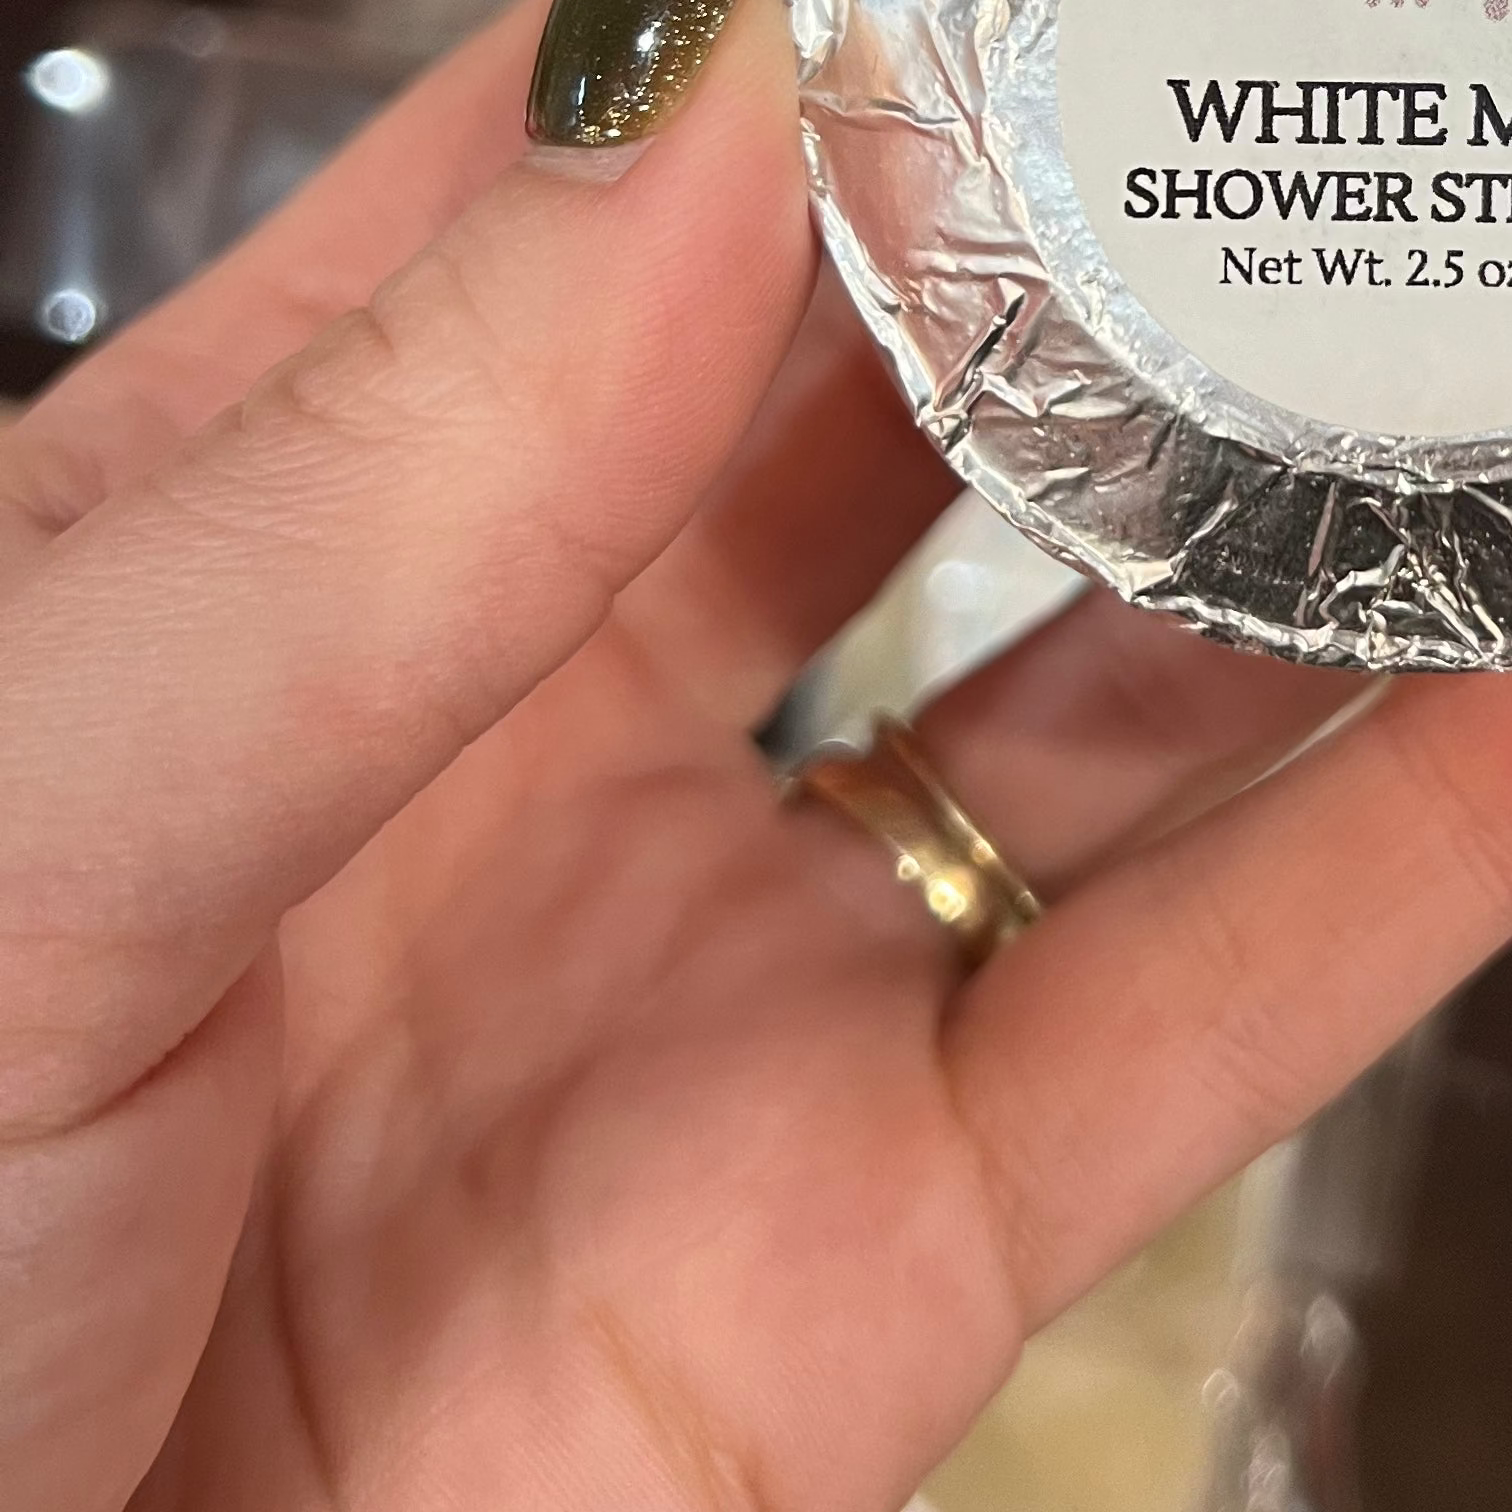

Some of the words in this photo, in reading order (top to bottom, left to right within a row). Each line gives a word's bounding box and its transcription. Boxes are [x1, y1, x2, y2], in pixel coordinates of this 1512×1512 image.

[1166, 78, 1449, 146] WHITE
[1124, 167, 1419, 223] SHOWER
[1219, 246, 1303, 286] Net
[1311, 248, 1392, 288] Wt.
[1405, 249, 1464, 289] 2.5
